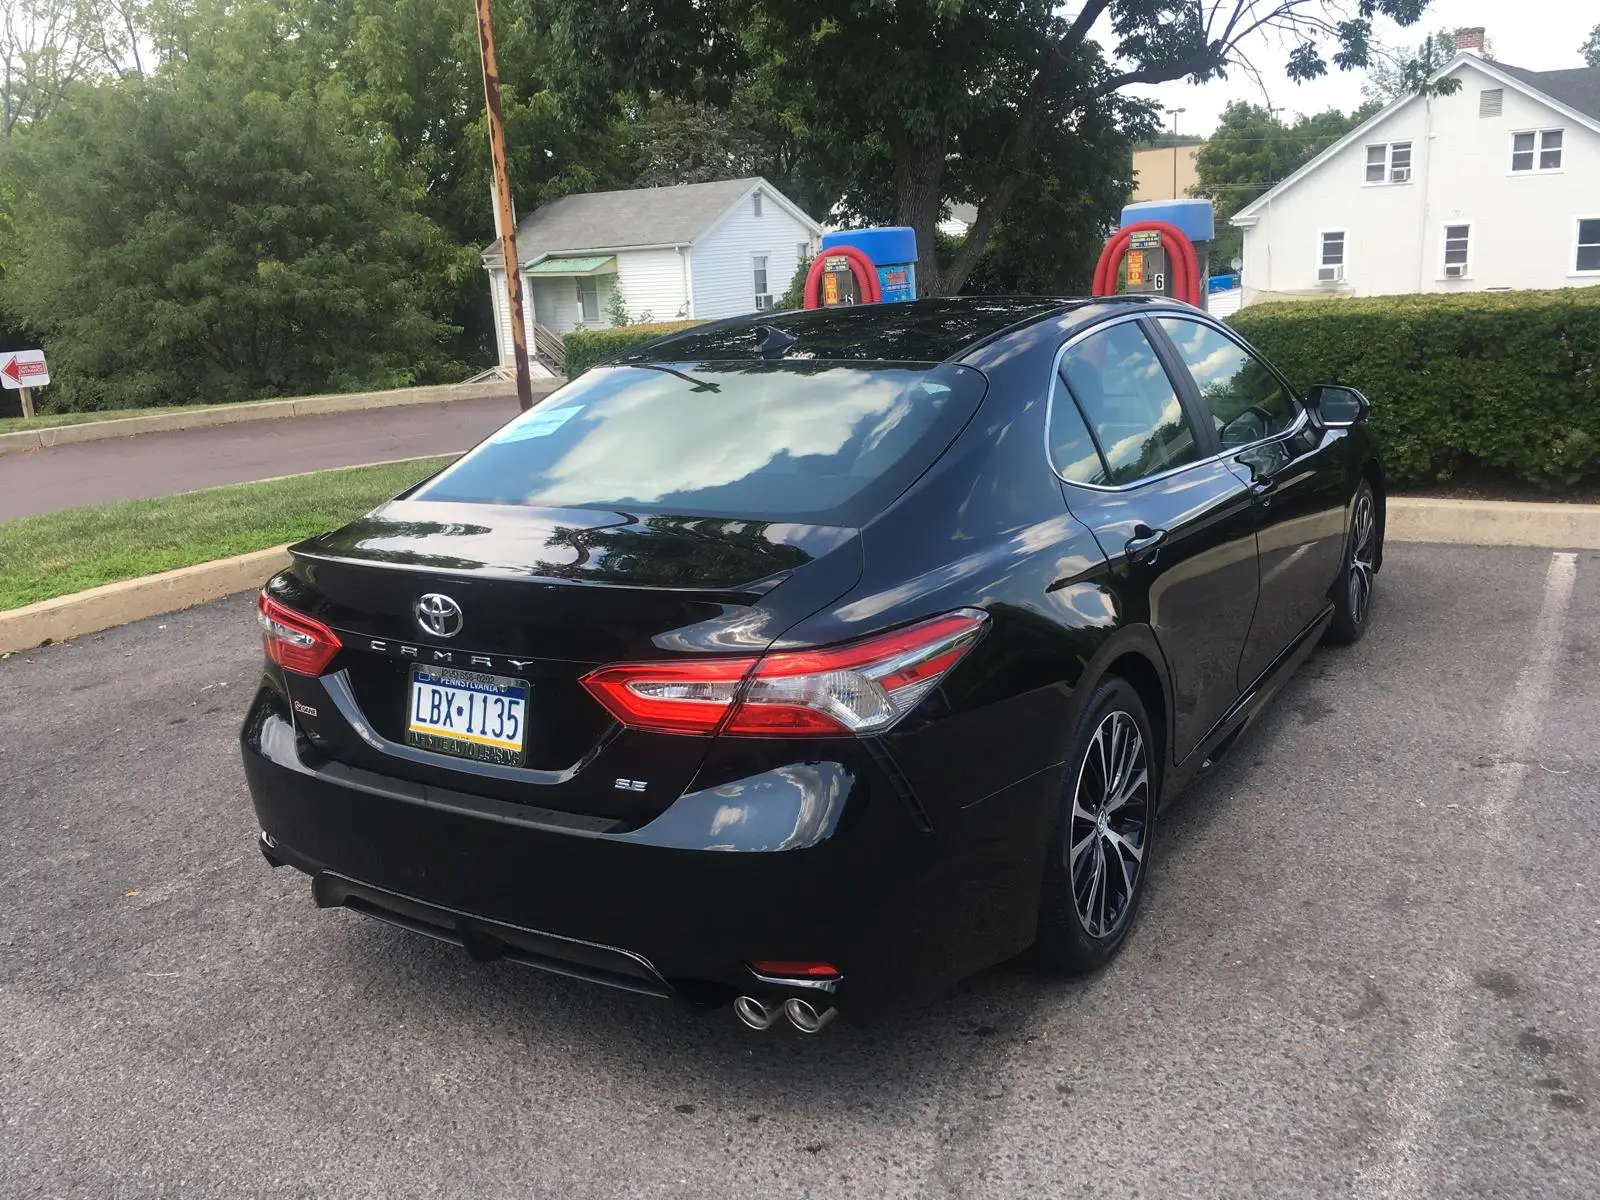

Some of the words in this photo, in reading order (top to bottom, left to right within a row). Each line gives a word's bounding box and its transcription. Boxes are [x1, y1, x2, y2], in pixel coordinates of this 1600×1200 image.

[1156, 275, 1163, 289] 6
[370, 640, 534, 671] CAMRY
[614, 778, 648, 792] SE
